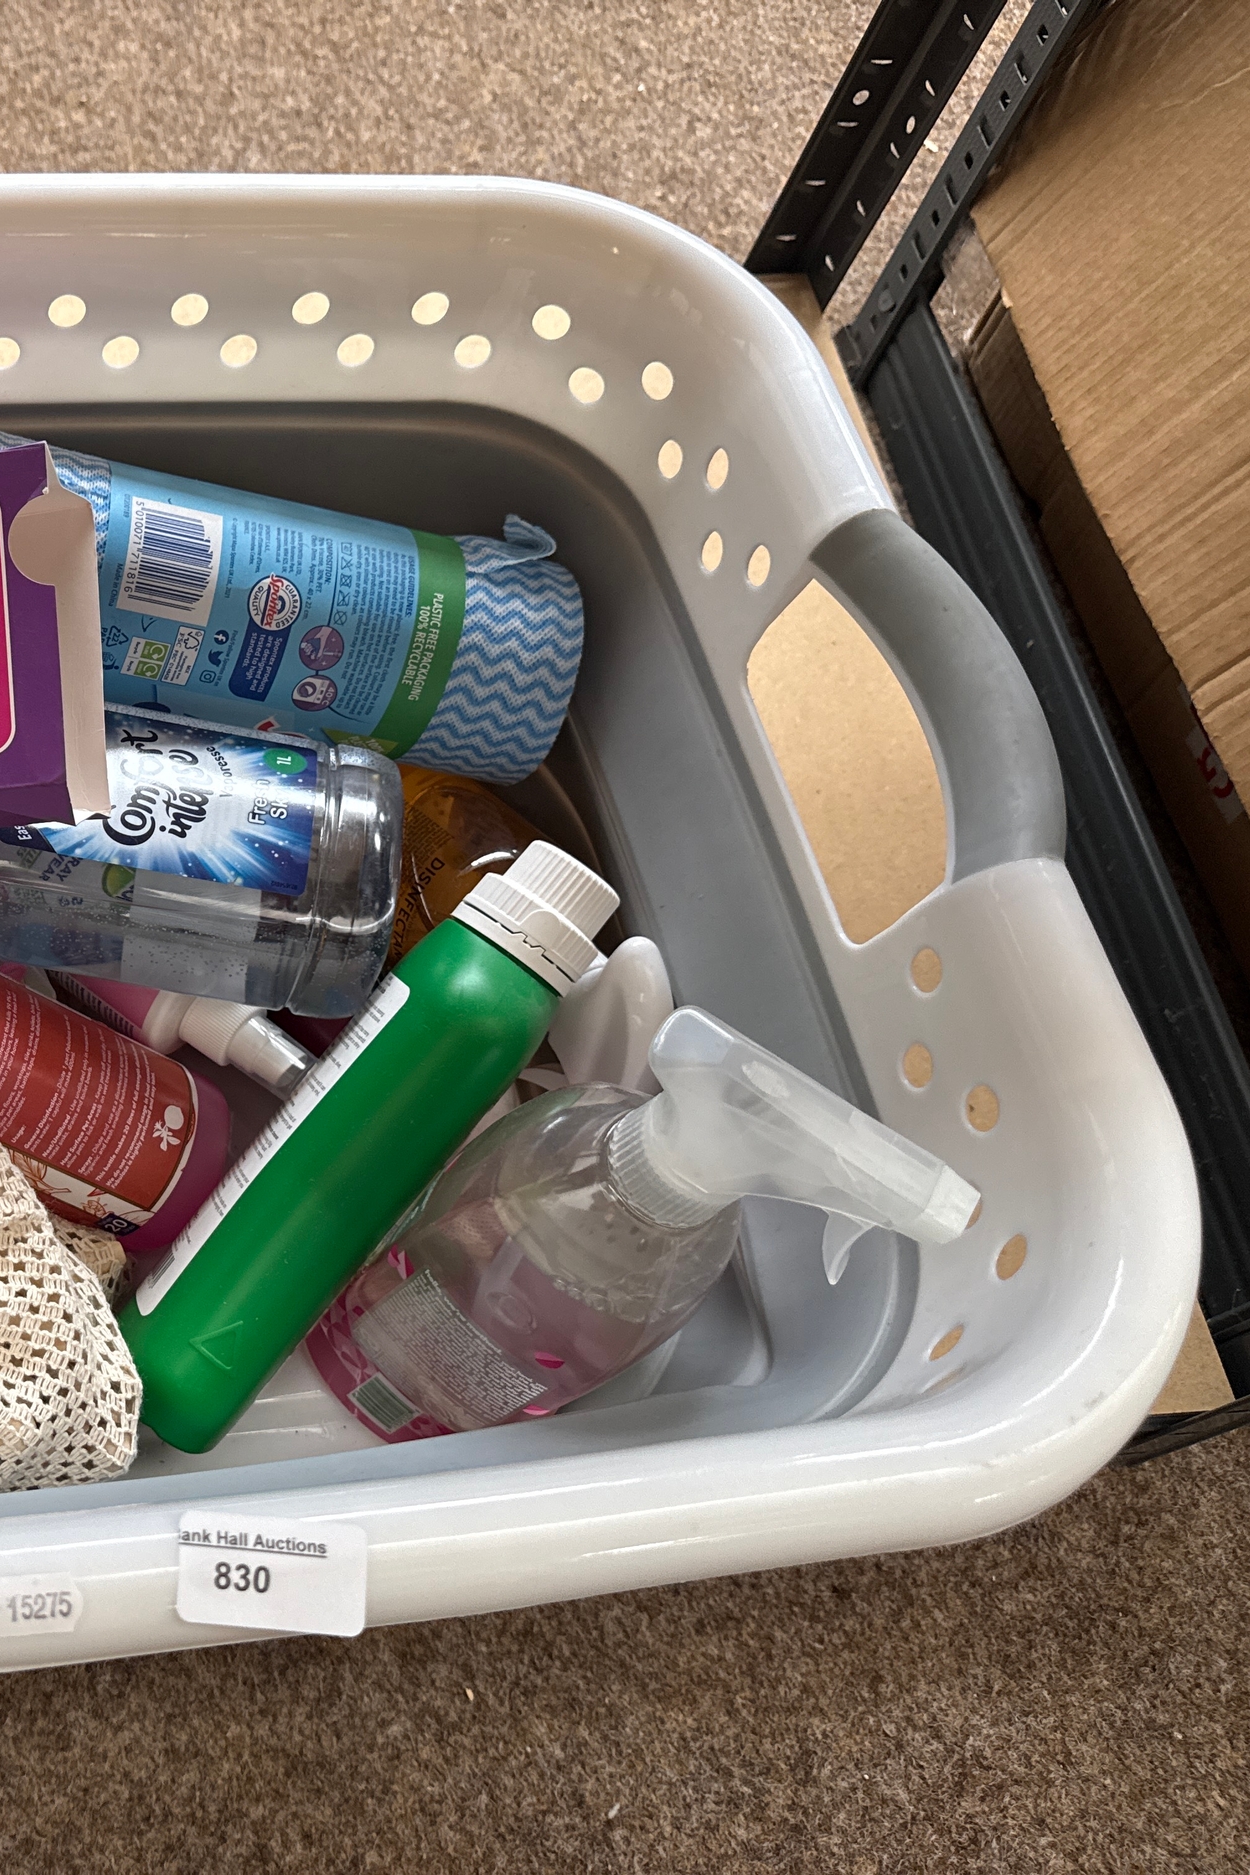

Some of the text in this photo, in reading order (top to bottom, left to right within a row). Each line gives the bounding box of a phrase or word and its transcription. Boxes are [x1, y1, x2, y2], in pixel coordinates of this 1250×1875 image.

[132, 509, 143, 545] 010071
[122, 552, 139, 593] 711816
[323, 537, 332, 584] COMPOSITION:
[407, 555, 415, 575] USAGE
[107, 562, 123, 607] Made in China
[250, 585, 262, 617] QUALITY
[263, 573, 284, 628] Spontex
[305, 600, 312, 609] 22
[274, 583, 302, 631] GUARANTEED
[111, 632, 120, 642] 22
[175, 632, 184, 648] FSC
[241, 631, 257, 668] standards.
[244, 633, 266, 680] tested to high
[401, 605, 429, 685] 100% RECYCLABLE
[407, 592, 443, 701] PLASTIC FREE PACKAGING
[249, 635, 273, 691] are designed and
[256, 636, 283, 693] Spontex products
[276, 755, 291, 765] 1L
[102, 728, 176, 845] Comfort
[158, 749, 213, 838] intense
[247, 778, 270, 824] Fresh
[393, 857, 446, 959] DISINFECTAN
[10, 1123, 26, 1143] Usage:
[23, 1091, 59, 1149] General Disinfection
[105, 1219, 128, 1232] 20
[180, 1530, 327, 1554] ank Hall Auctions
[214, 1561, 270, 1593] 830
[7, 1591, 73, 1622] 15275
